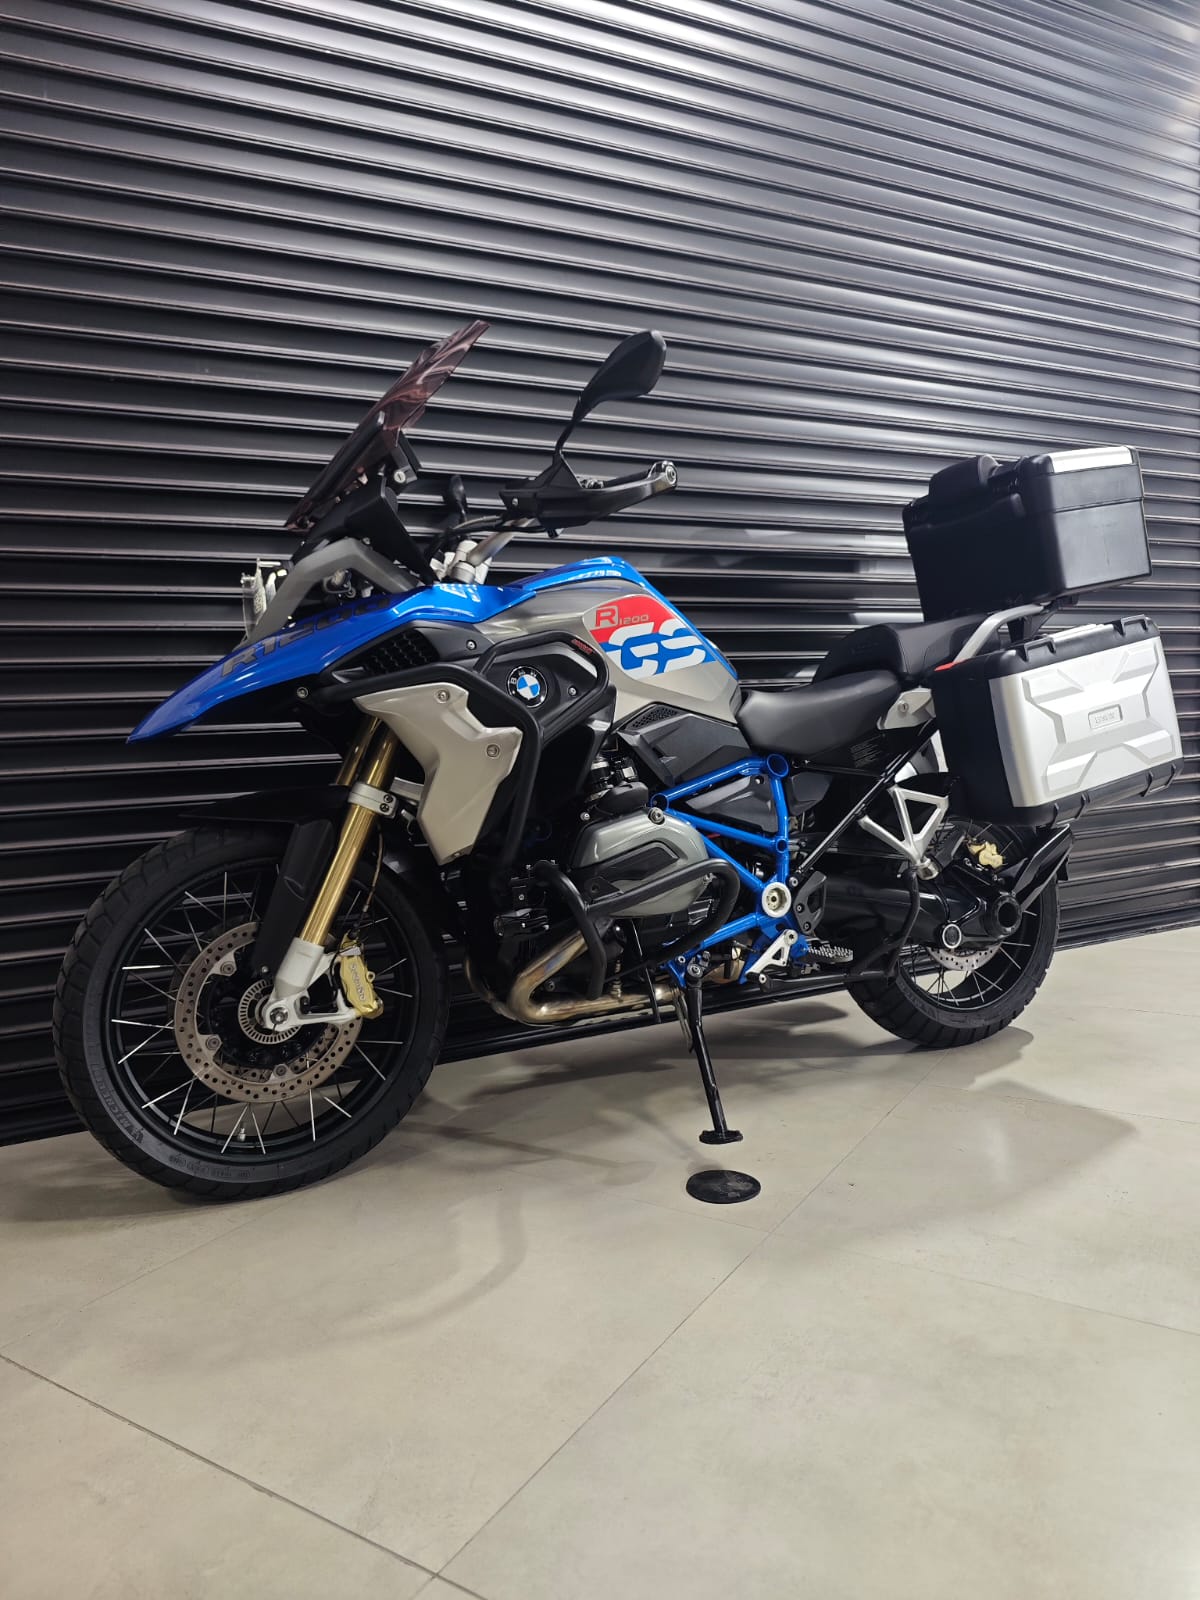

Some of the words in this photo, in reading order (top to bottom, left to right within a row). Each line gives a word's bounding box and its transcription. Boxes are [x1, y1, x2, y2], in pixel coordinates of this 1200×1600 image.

[595, 608, 616, 627] R
[619, 614, 649, 625] 1200
[606, 618, 706, 680] GS
